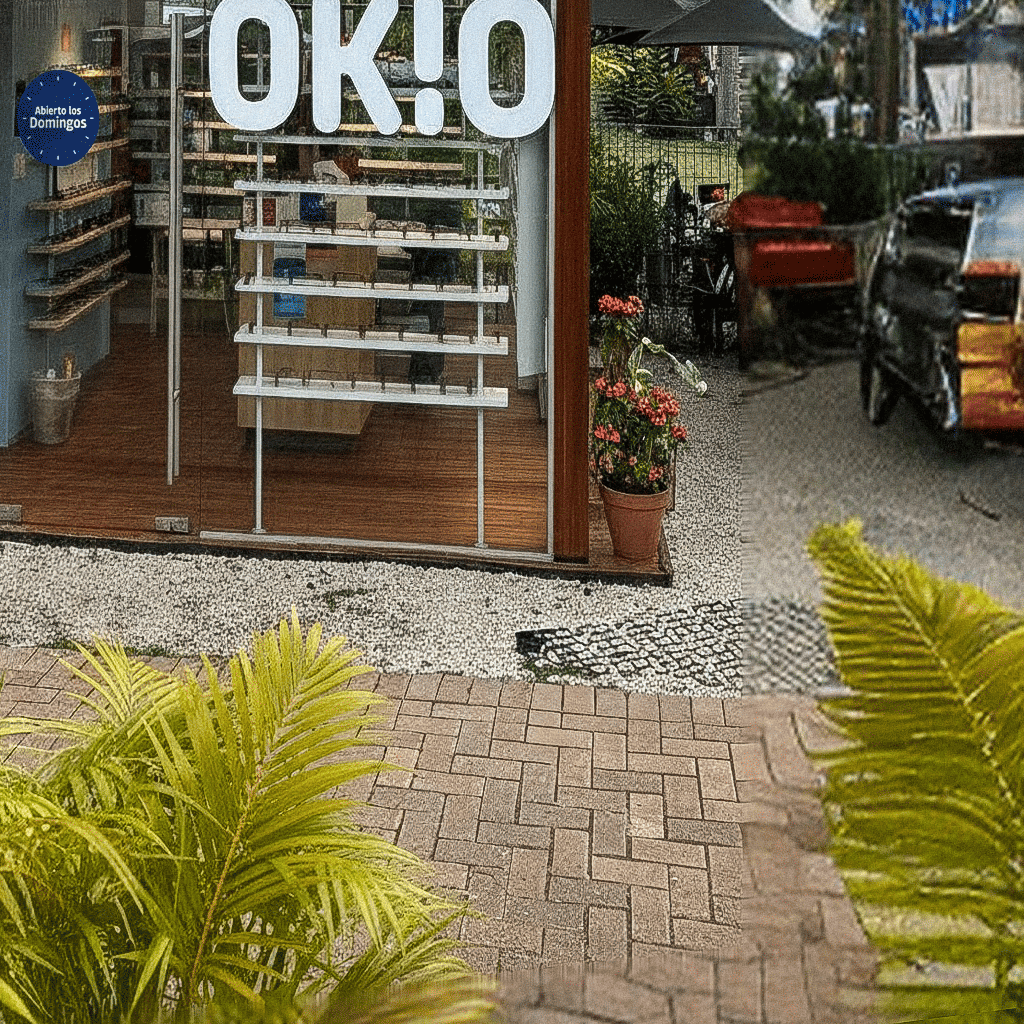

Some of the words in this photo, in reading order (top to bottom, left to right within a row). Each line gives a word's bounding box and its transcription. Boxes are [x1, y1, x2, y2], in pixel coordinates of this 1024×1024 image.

[34, 105, 67, 115] Abierto
[68, 105, 82, 115] los
[29, 115, 87, 132] Domingos
